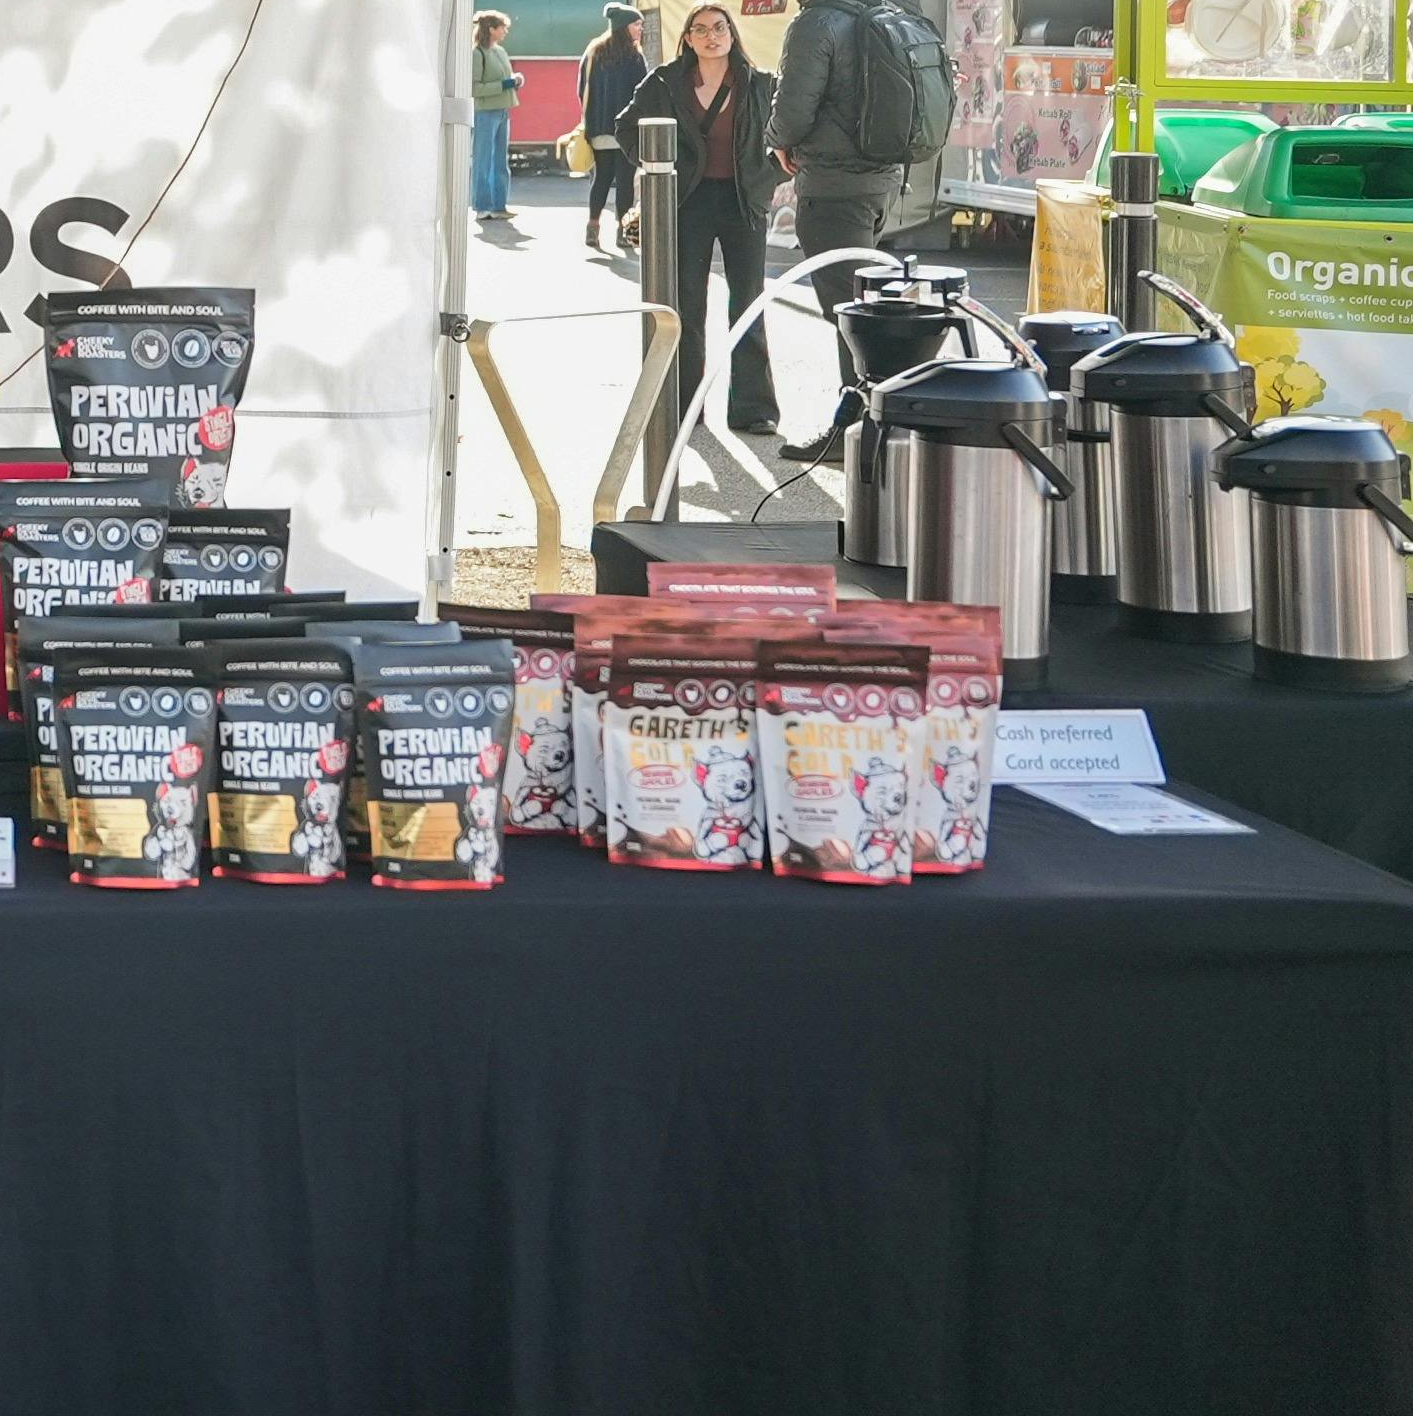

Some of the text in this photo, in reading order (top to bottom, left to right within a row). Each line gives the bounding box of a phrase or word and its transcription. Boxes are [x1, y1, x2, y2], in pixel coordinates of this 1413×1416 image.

[1267, 251, 1413, 291] Organic
[1267, 289, 1413, 310] Food scraps coffee cup
[1278, 307, 1335, 321] serviettes
[1346, 311, 1365, 323] hot
[1369, 313, 1395, 325] food
[77, 335, 115, 346] CHEEKY
[77, 343, 105, 353] DEVIL
[77, 350, 126, 360] ROASTERS
[96, 461, 123, 474] ORIGIN
[123, 461, 149, 474] BEANS
[628, 714, 751, 742] GARETH'S
[995, 724, 1114, 747] Cash preferred
[1005, 753, 1121, 774] Card accepted
